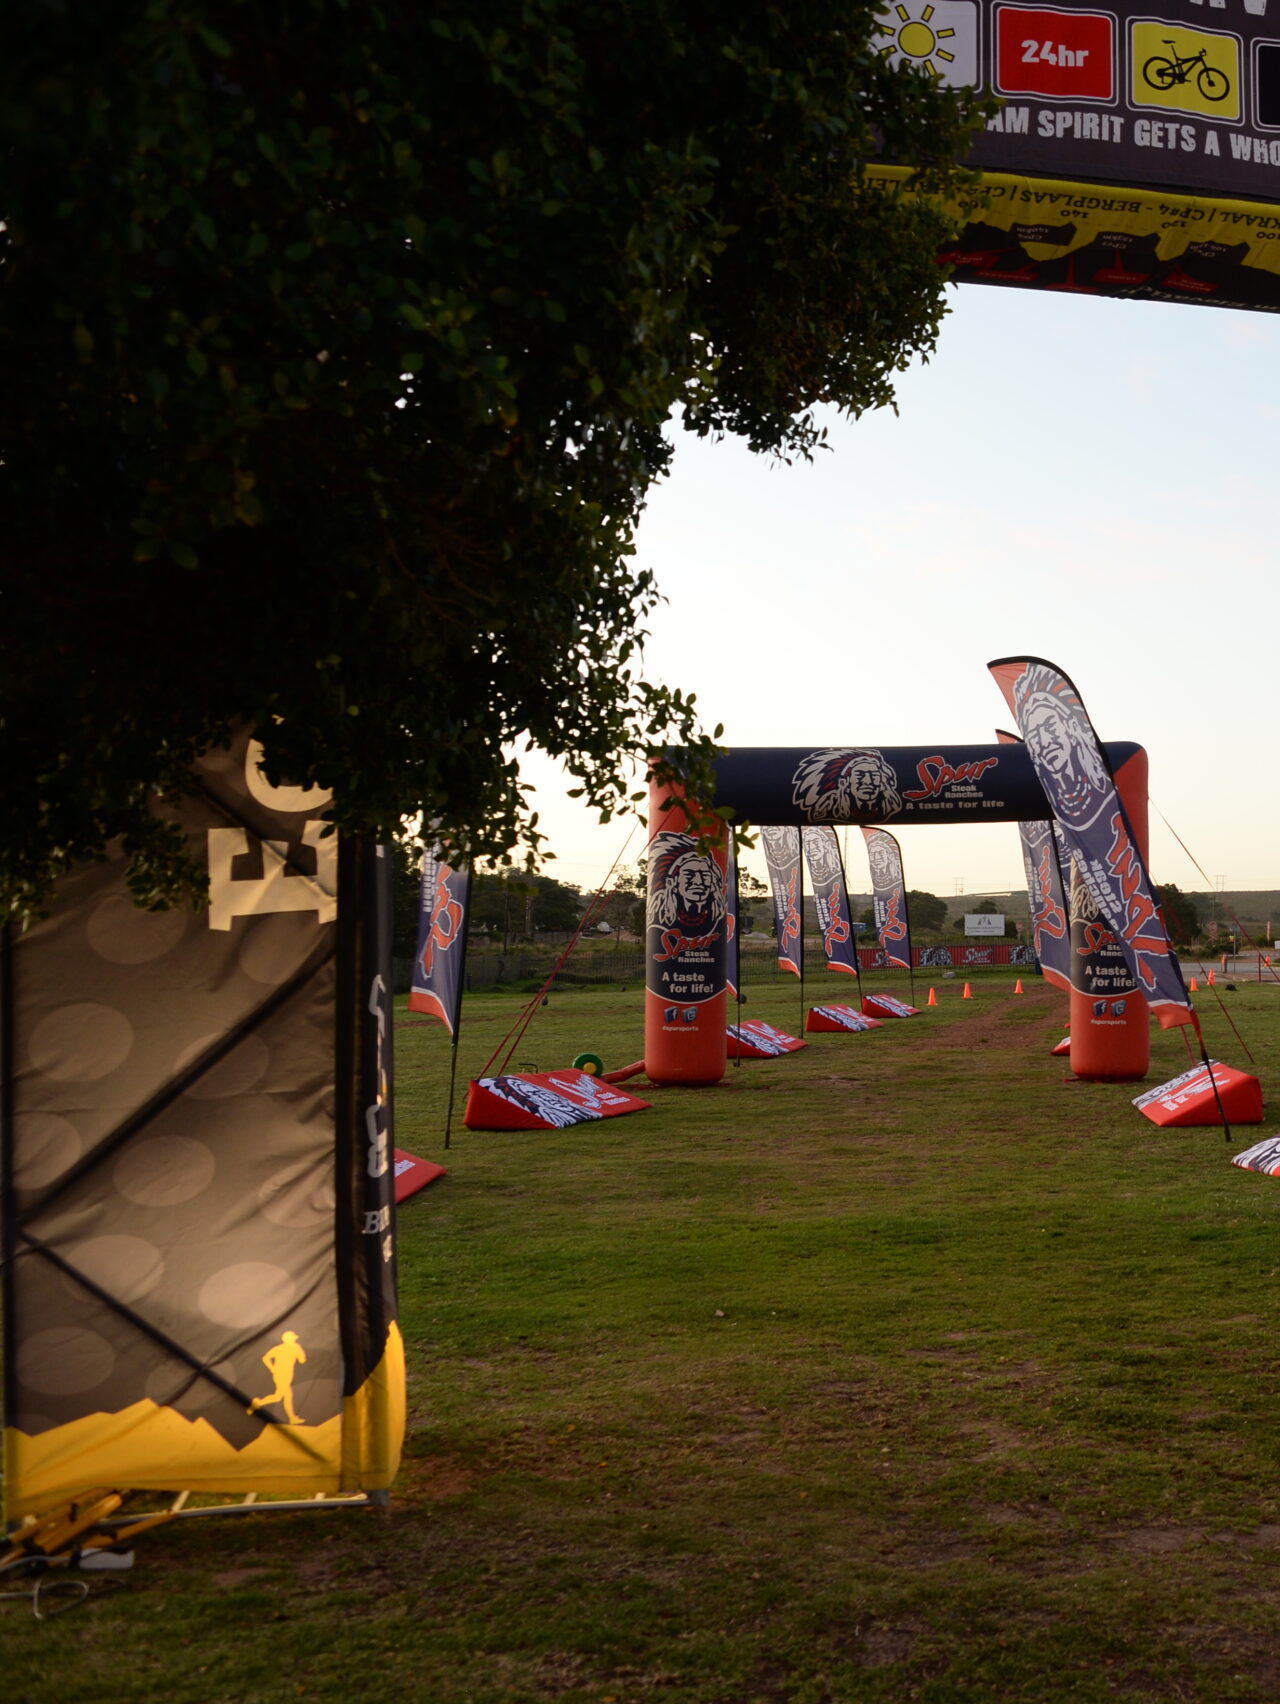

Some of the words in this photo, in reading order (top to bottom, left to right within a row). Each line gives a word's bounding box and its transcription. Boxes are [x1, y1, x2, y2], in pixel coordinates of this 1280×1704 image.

[1020, 39, 1089, 69] 24hr
[1037, 110, 1125, 144] SPIRIT
[1133, 119, 1196, 152] GETS
[1204, 130, 1221, 157] A
[1019, 189, 1142, 214] BERGPLAAS
[1060, 208, 1089, 219] 140
[1158, 203, 1206, 221] CP#4
[902, 755, 999, 801] Spur
[905, 802, 914, 810] A
[919, 801, 954, 810] taste
[958, 801, 978, 809] for
[982, 800, 1005, 808] life
[652, 928, 721, 962] Spur
[662, 972, 670, 981] A
[673, 972, 705, 982] taste
[1085, 966, 1092, 975] A
[1095, 966, 1127, 976] taste
[669, 983, 688, 993] for
[691, 983, 713, 993] life!
[1091, 977, 1110, 987] for
[1113, 977, 1136, 987] life!
